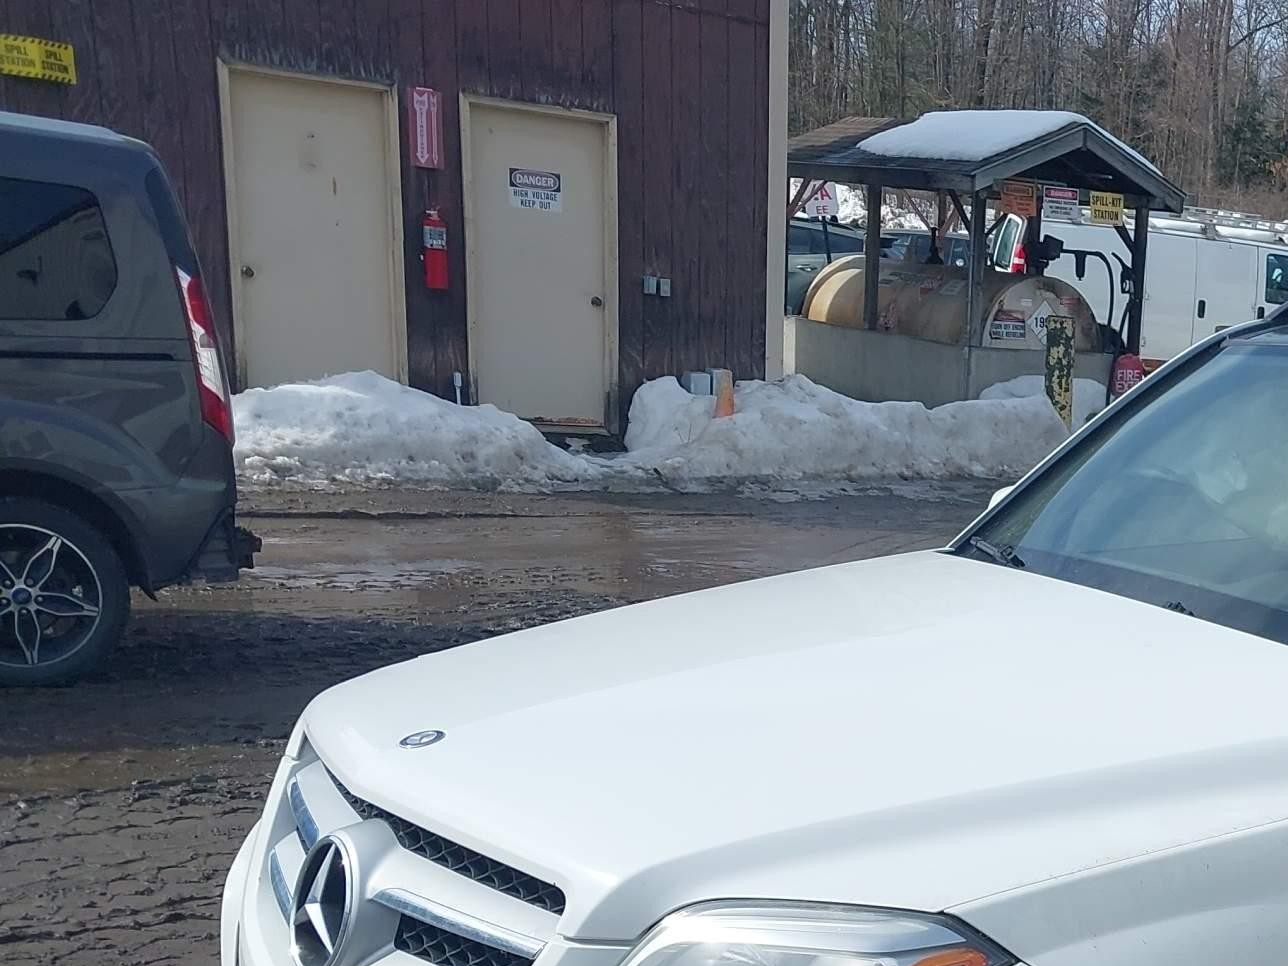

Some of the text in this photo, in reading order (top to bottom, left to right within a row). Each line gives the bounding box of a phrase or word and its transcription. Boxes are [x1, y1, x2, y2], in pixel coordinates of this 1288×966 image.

[44, 49, 63, 62] SPILL
[41, 60, 69, 74] STATION
[516, 173, 554, 187] DANGER
[513, 188, 558, 202] HIGH VOLTAGE
[1092, 195, 1121, 207] SPILL-KIT
[520, 199, 551, 210] KEEP OUT
[1093, 209, 1119, 221] STATION
[1117, 369, 1140, 381] FIRE
